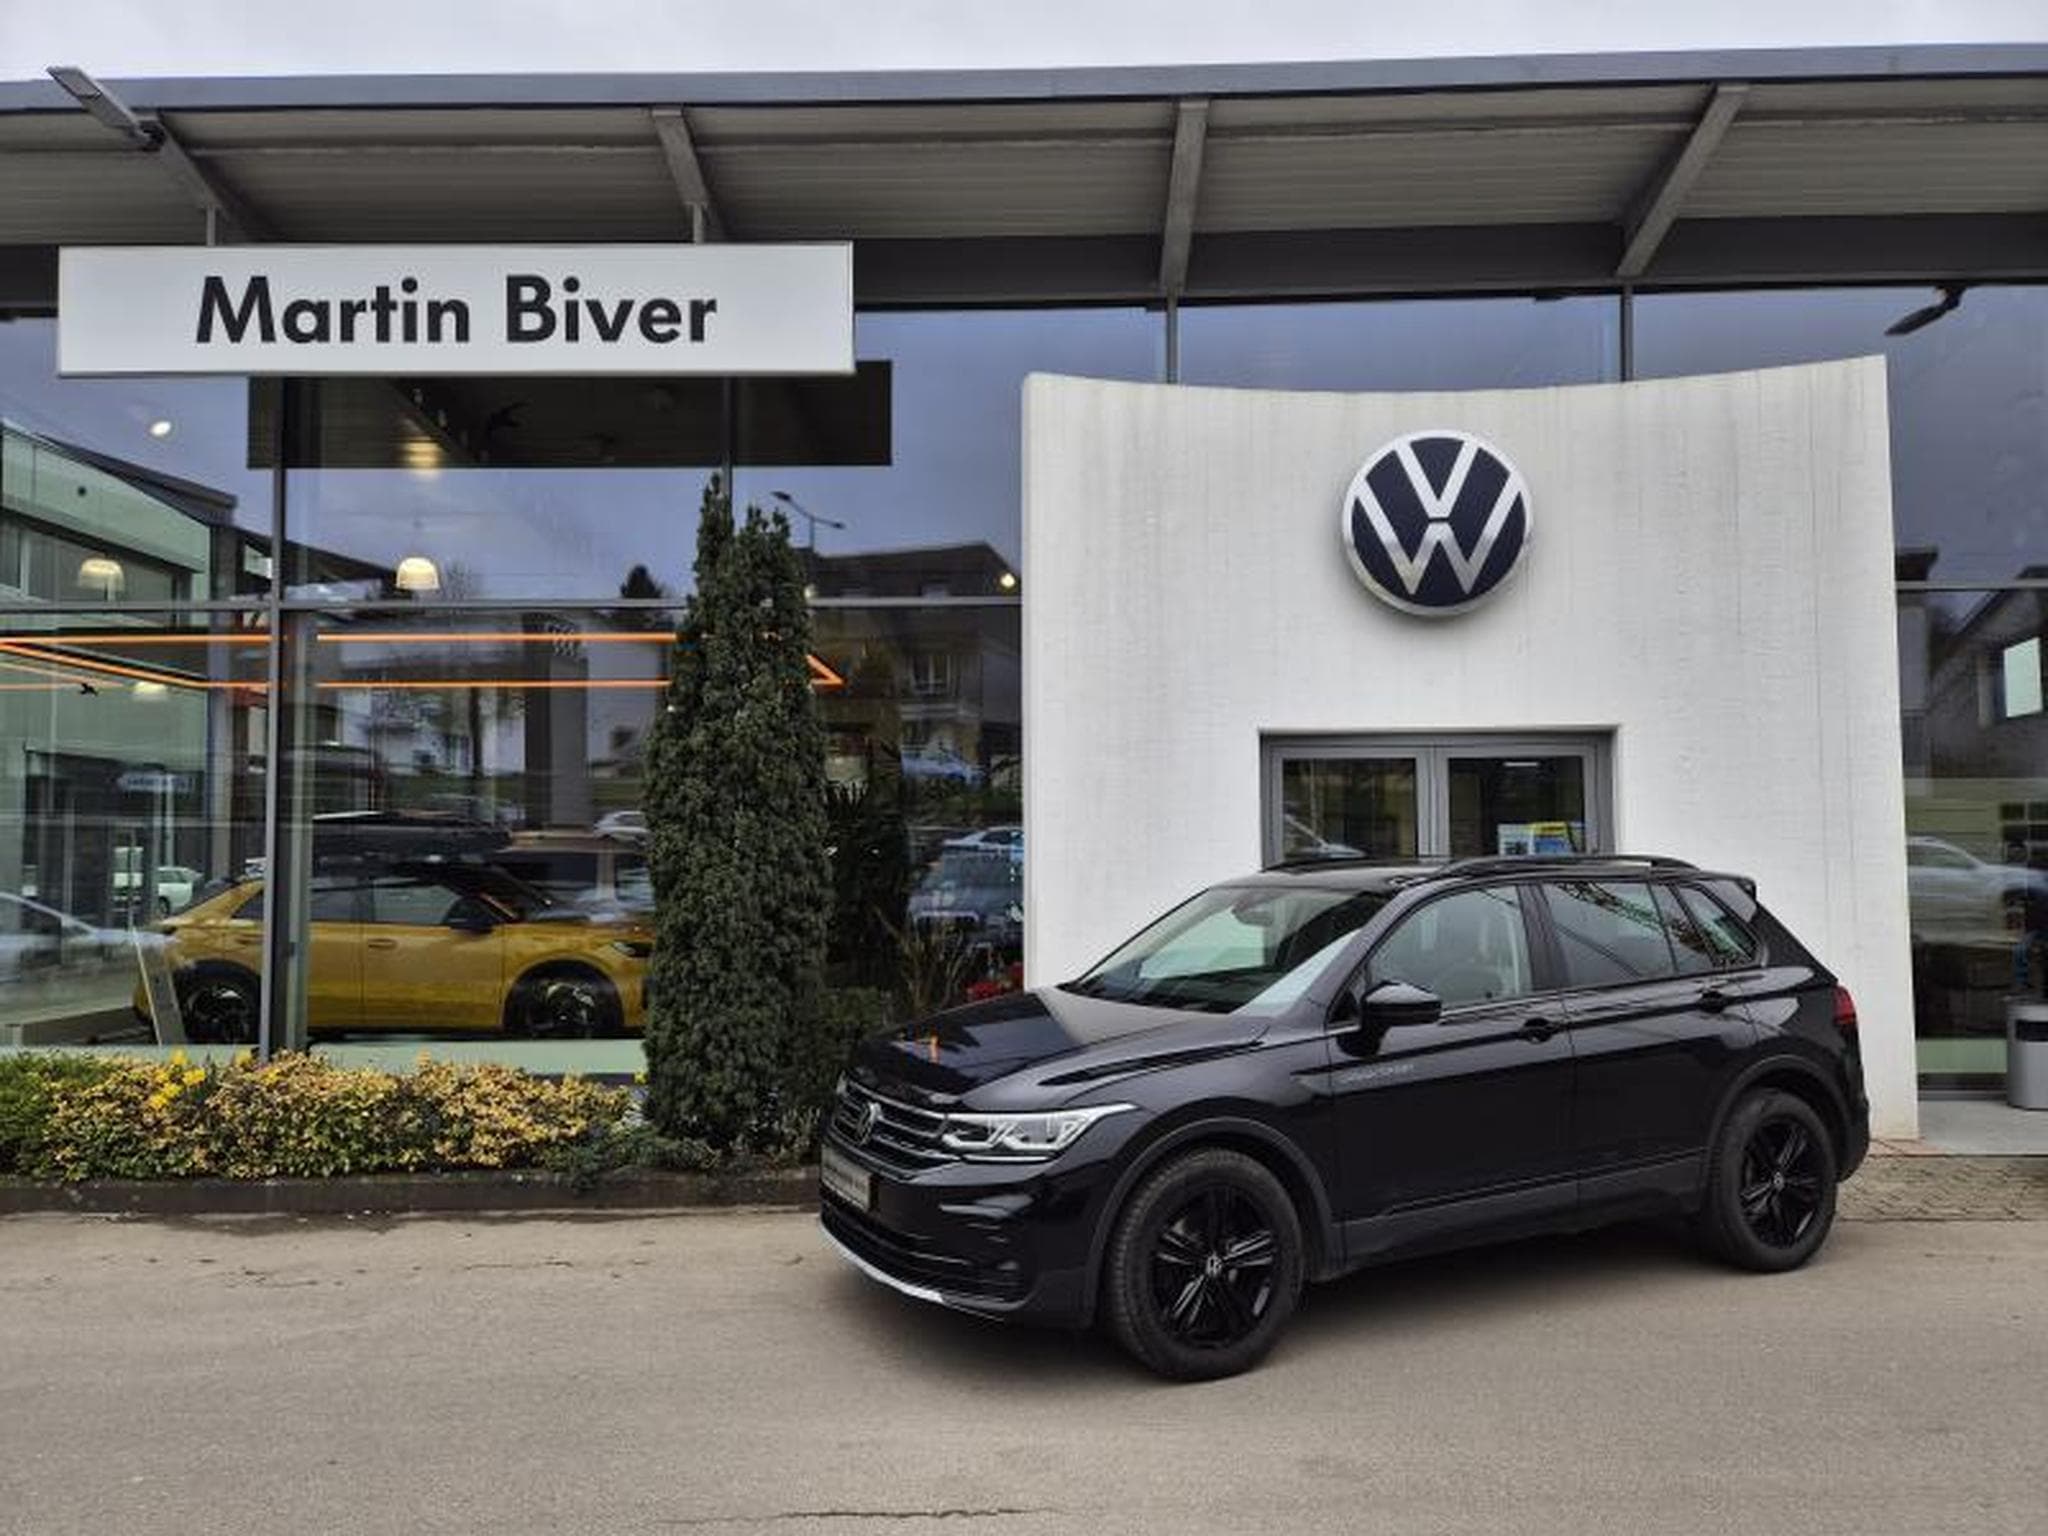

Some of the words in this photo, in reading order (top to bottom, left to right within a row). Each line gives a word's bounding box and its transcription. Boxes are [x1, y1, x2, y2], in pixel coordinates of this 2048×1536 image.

[196, 275, 470, 343] Martin
[506, 274, 718, 343] Biver
[1348, 434, 1529, 602] VW
